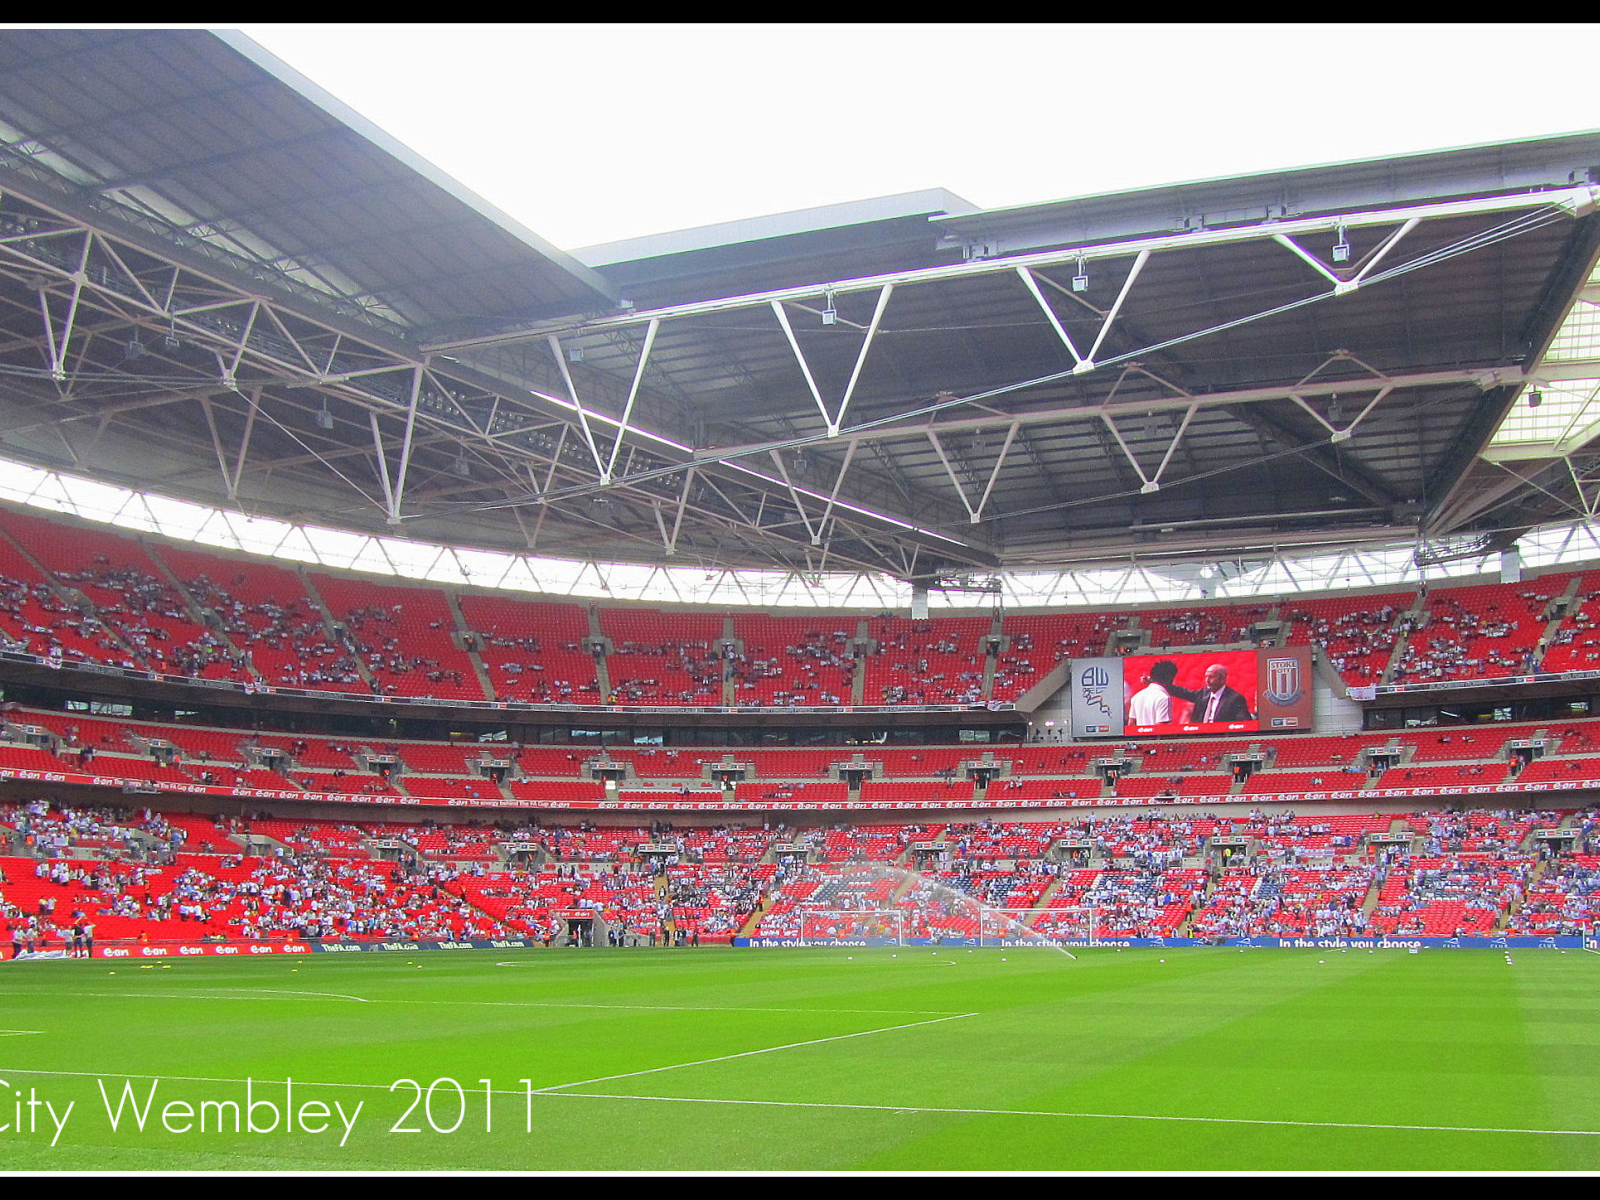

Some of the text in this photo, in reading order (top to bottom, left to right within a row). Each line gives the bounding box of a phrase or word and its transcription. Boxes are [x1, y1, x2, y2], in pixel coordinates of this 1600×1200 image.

[749, 939, 760, 947] In
[762, 938, 778, 947] the
[1001, 939, 1012, 947] In
[1014, 938, 1033, 947] the
[1279, 939, 1290, 948] In
[1294, 938, 1314, 948] the
[1318, 938, 1347, 948] style
